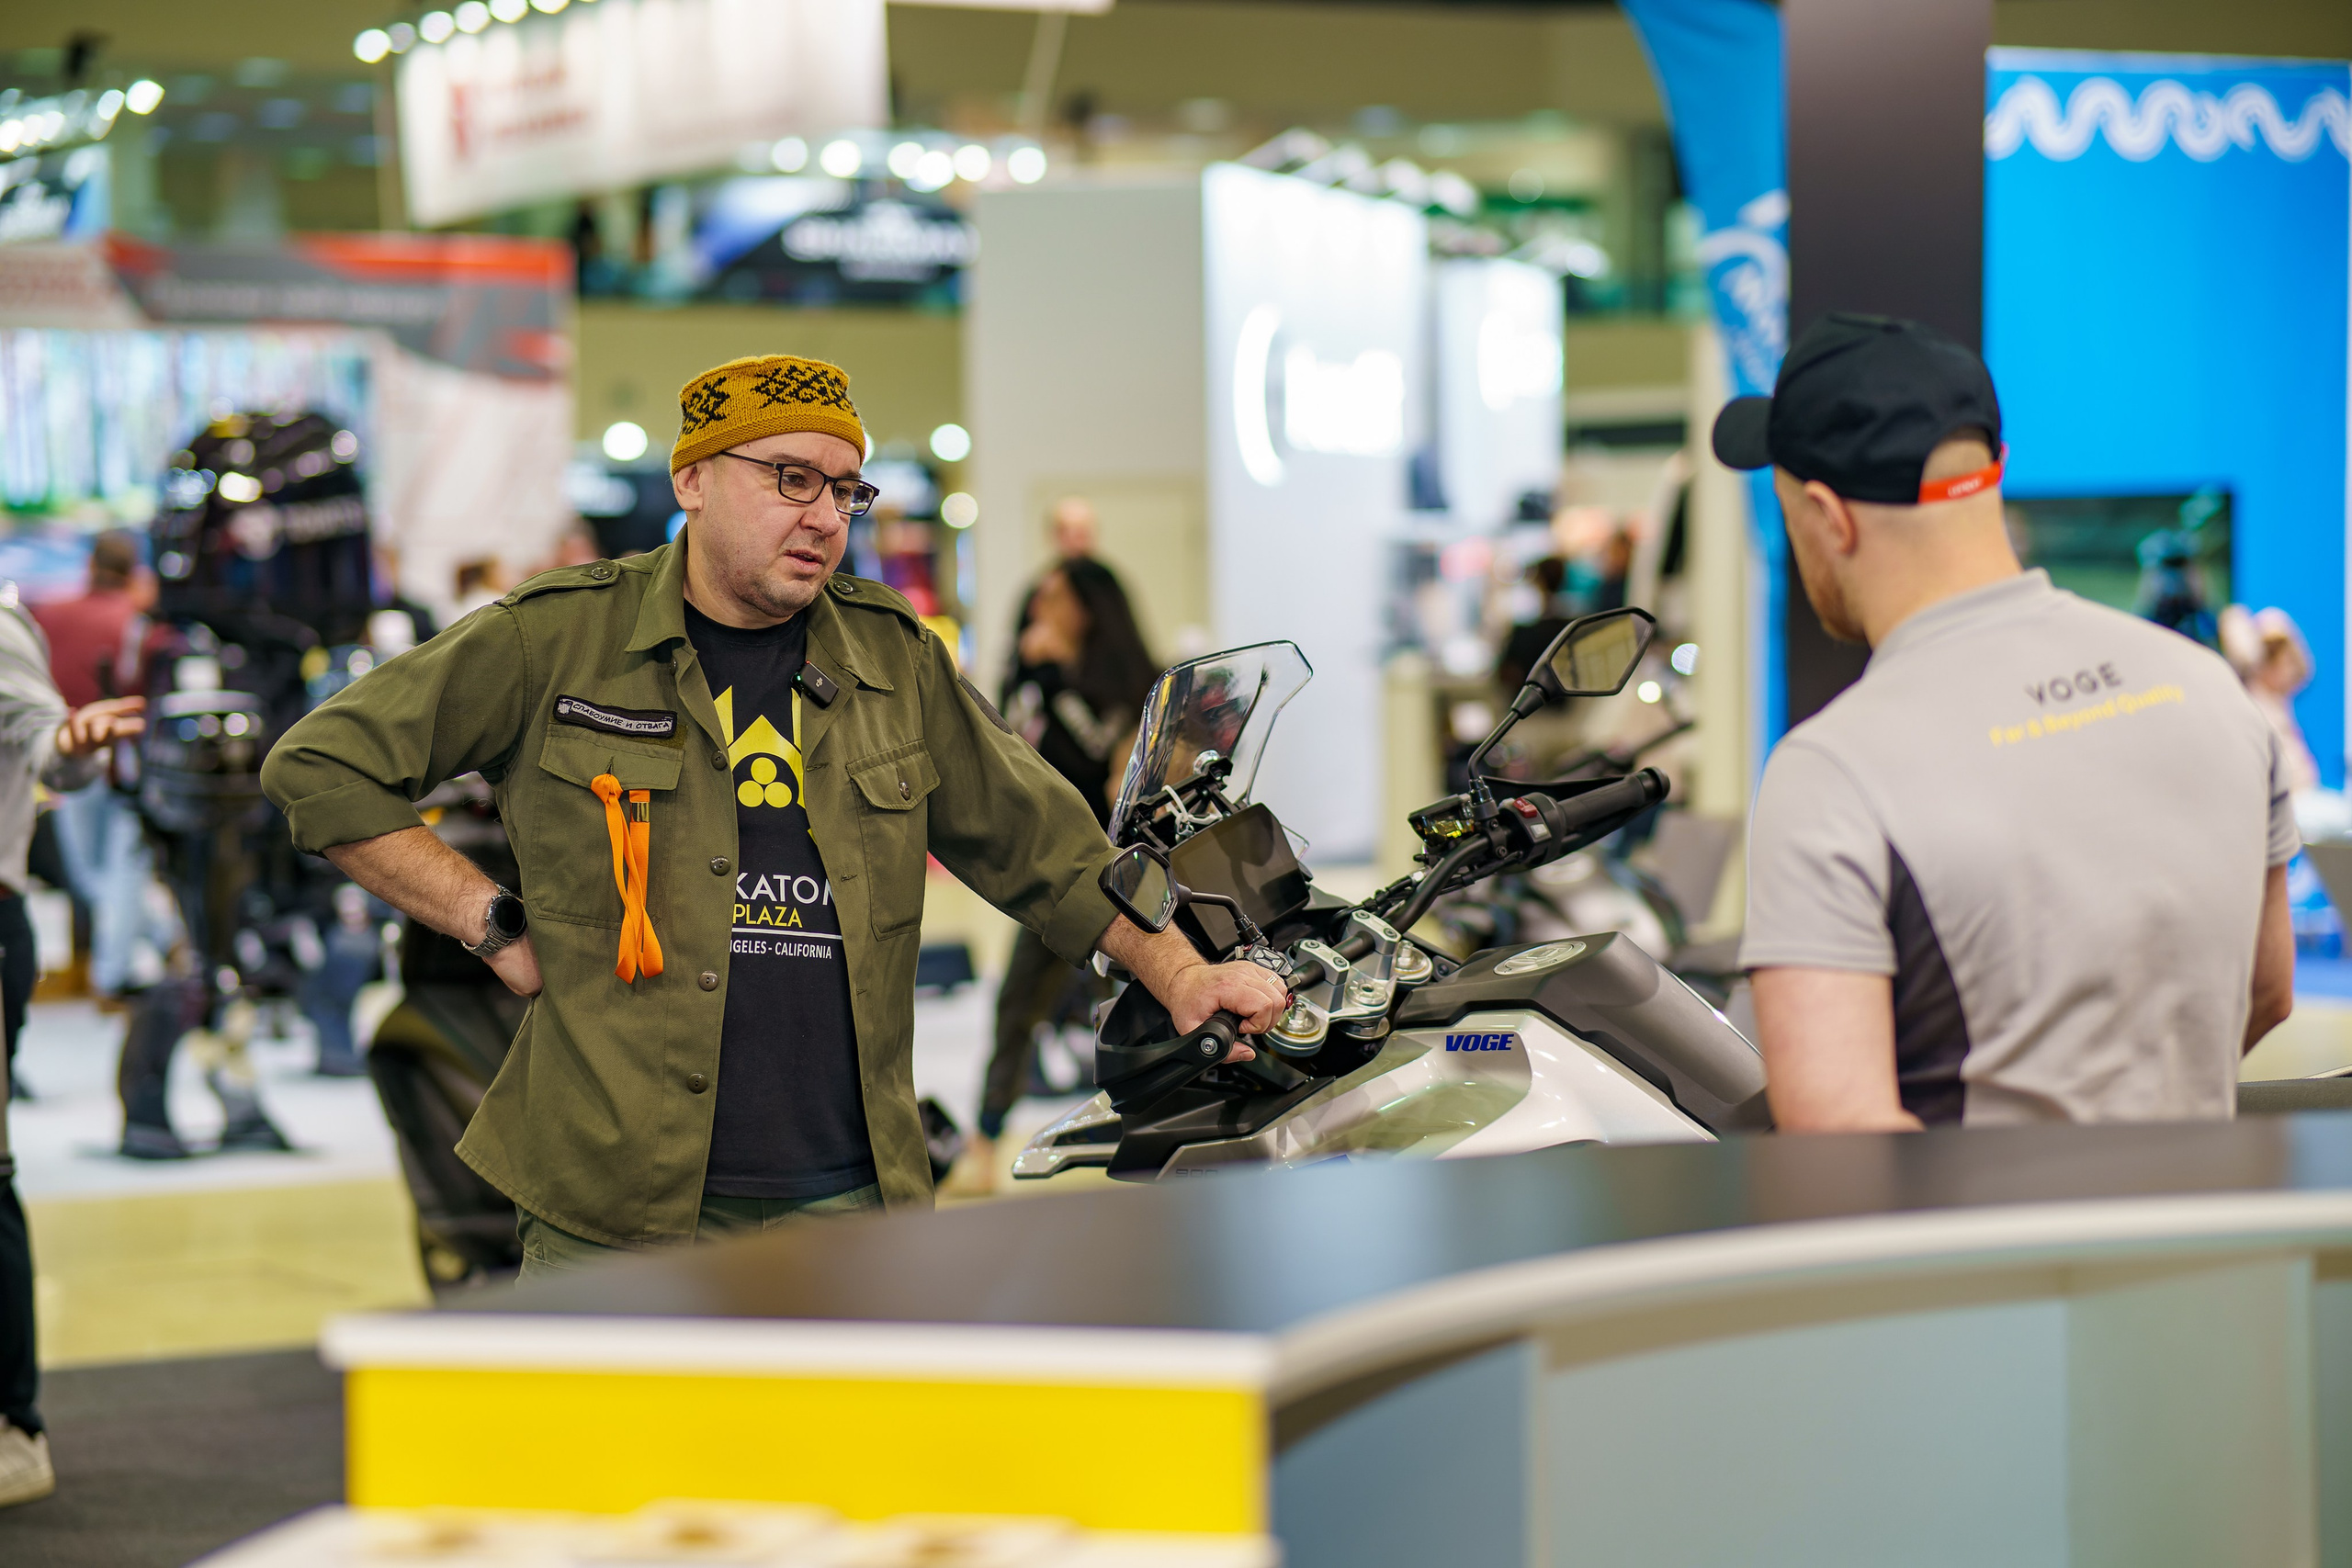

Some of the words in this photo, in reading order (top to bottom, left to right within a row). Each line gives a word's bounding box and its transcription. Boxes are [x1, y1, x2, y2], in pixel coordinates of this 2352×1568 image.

[2024, 661, 2122, 706] VOGE
[572, 704, 624, 726] СЛАБОУМИЕ
[636, 722, 670, 730] ОТВАГА
[732, 904, 803, 928] PLAZA
[775, 942, 832, 959] CALIFORNIA
[1445, 1033, 1514, 1052] VOGE
